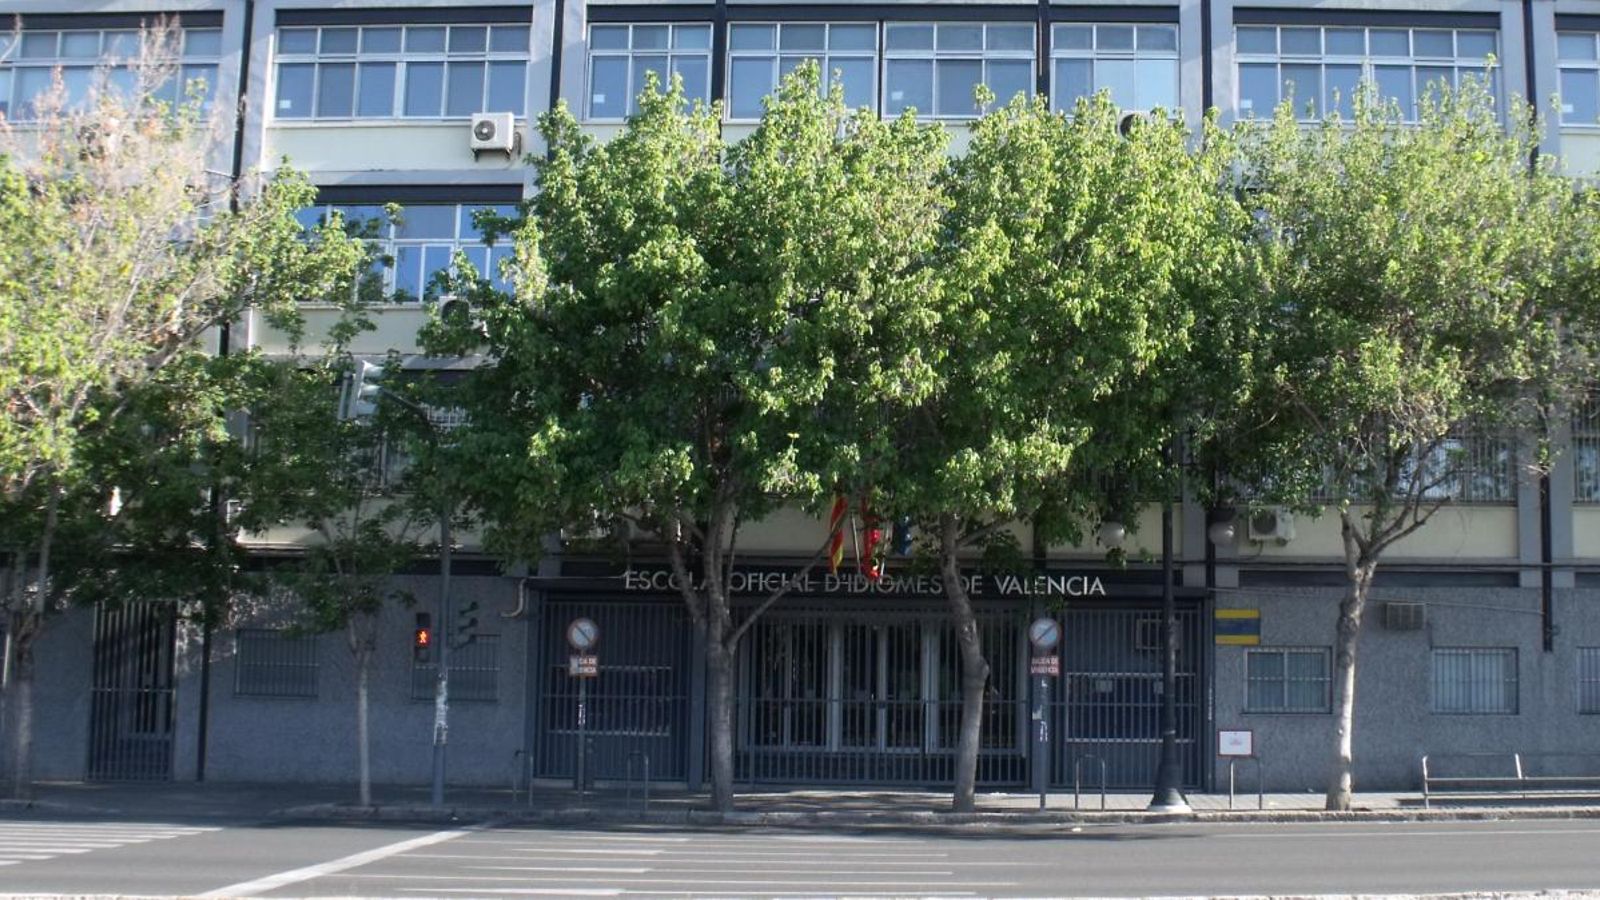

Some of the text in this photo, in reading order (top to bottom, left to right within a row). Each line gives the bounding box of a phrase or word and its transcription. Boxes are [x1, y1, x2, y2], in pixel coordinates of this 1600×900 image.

[625, 571, 708, 590] ESCOL
[728, 572, 816, 592] OFICIAL
[994, 575, 1107, 596] VALENCIA
